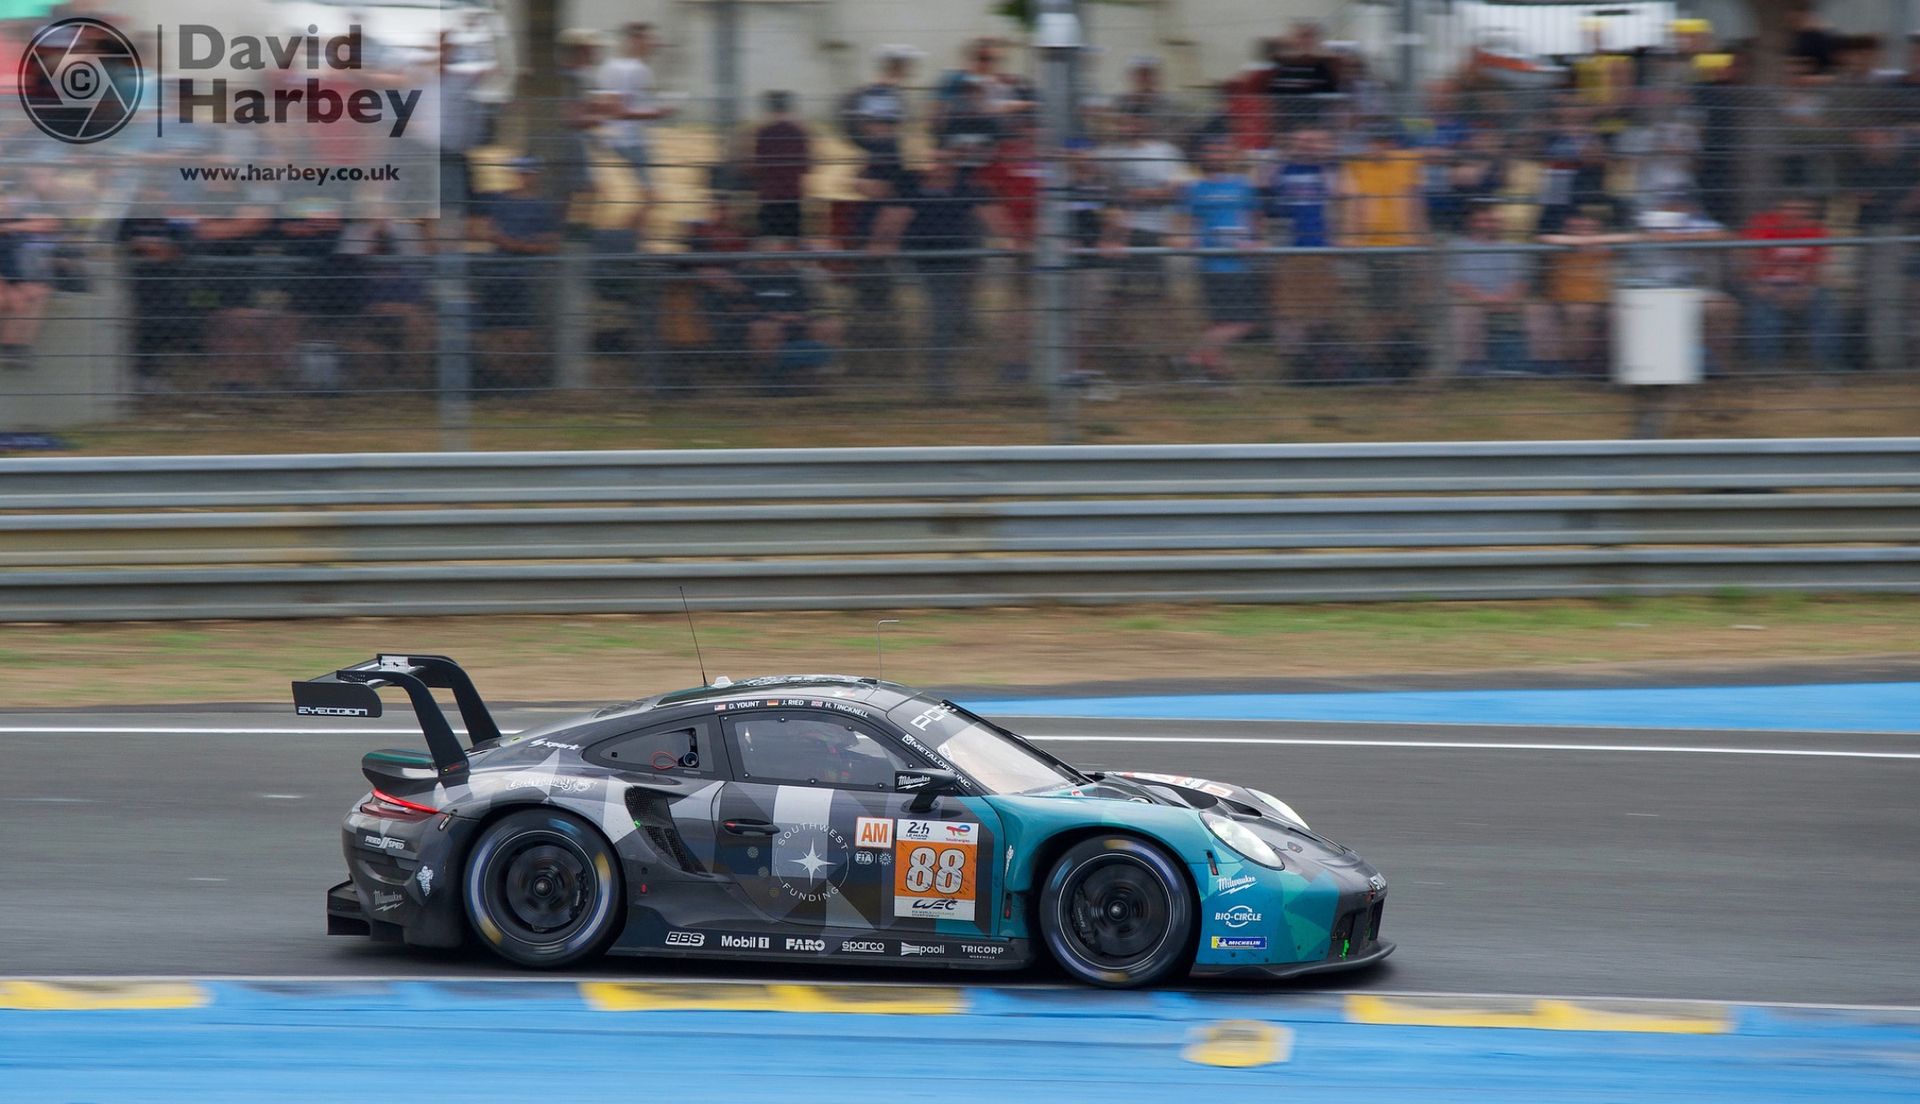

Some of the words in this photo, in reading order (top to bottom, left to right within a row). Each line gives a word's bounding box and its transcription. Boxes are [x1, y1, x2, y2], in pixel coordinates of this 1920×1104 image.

[737, 701, 760, 709] YOUNT
[833, 704, 869, 718] TINCKNELL
[777, 822, 849, 851] SOUTHWEST
[861, 822, 889, 843] AM
[906, 846, 966, 894] 88
[782, 883, 840, 902] FUNDING
[911, 899, 958, 911] WEC
[1215, 911, 1262, 922] BIO-CIRCLE
[665, 931, 706, 947] BBS
[721, 935, 756, 948] Mobil
[785, 938, 826, 951] FARO
[841, 940, 885, 952] sparco
[919, 944, 945, 956] paoli
[961, 945, 1004, 955] TRICORP
